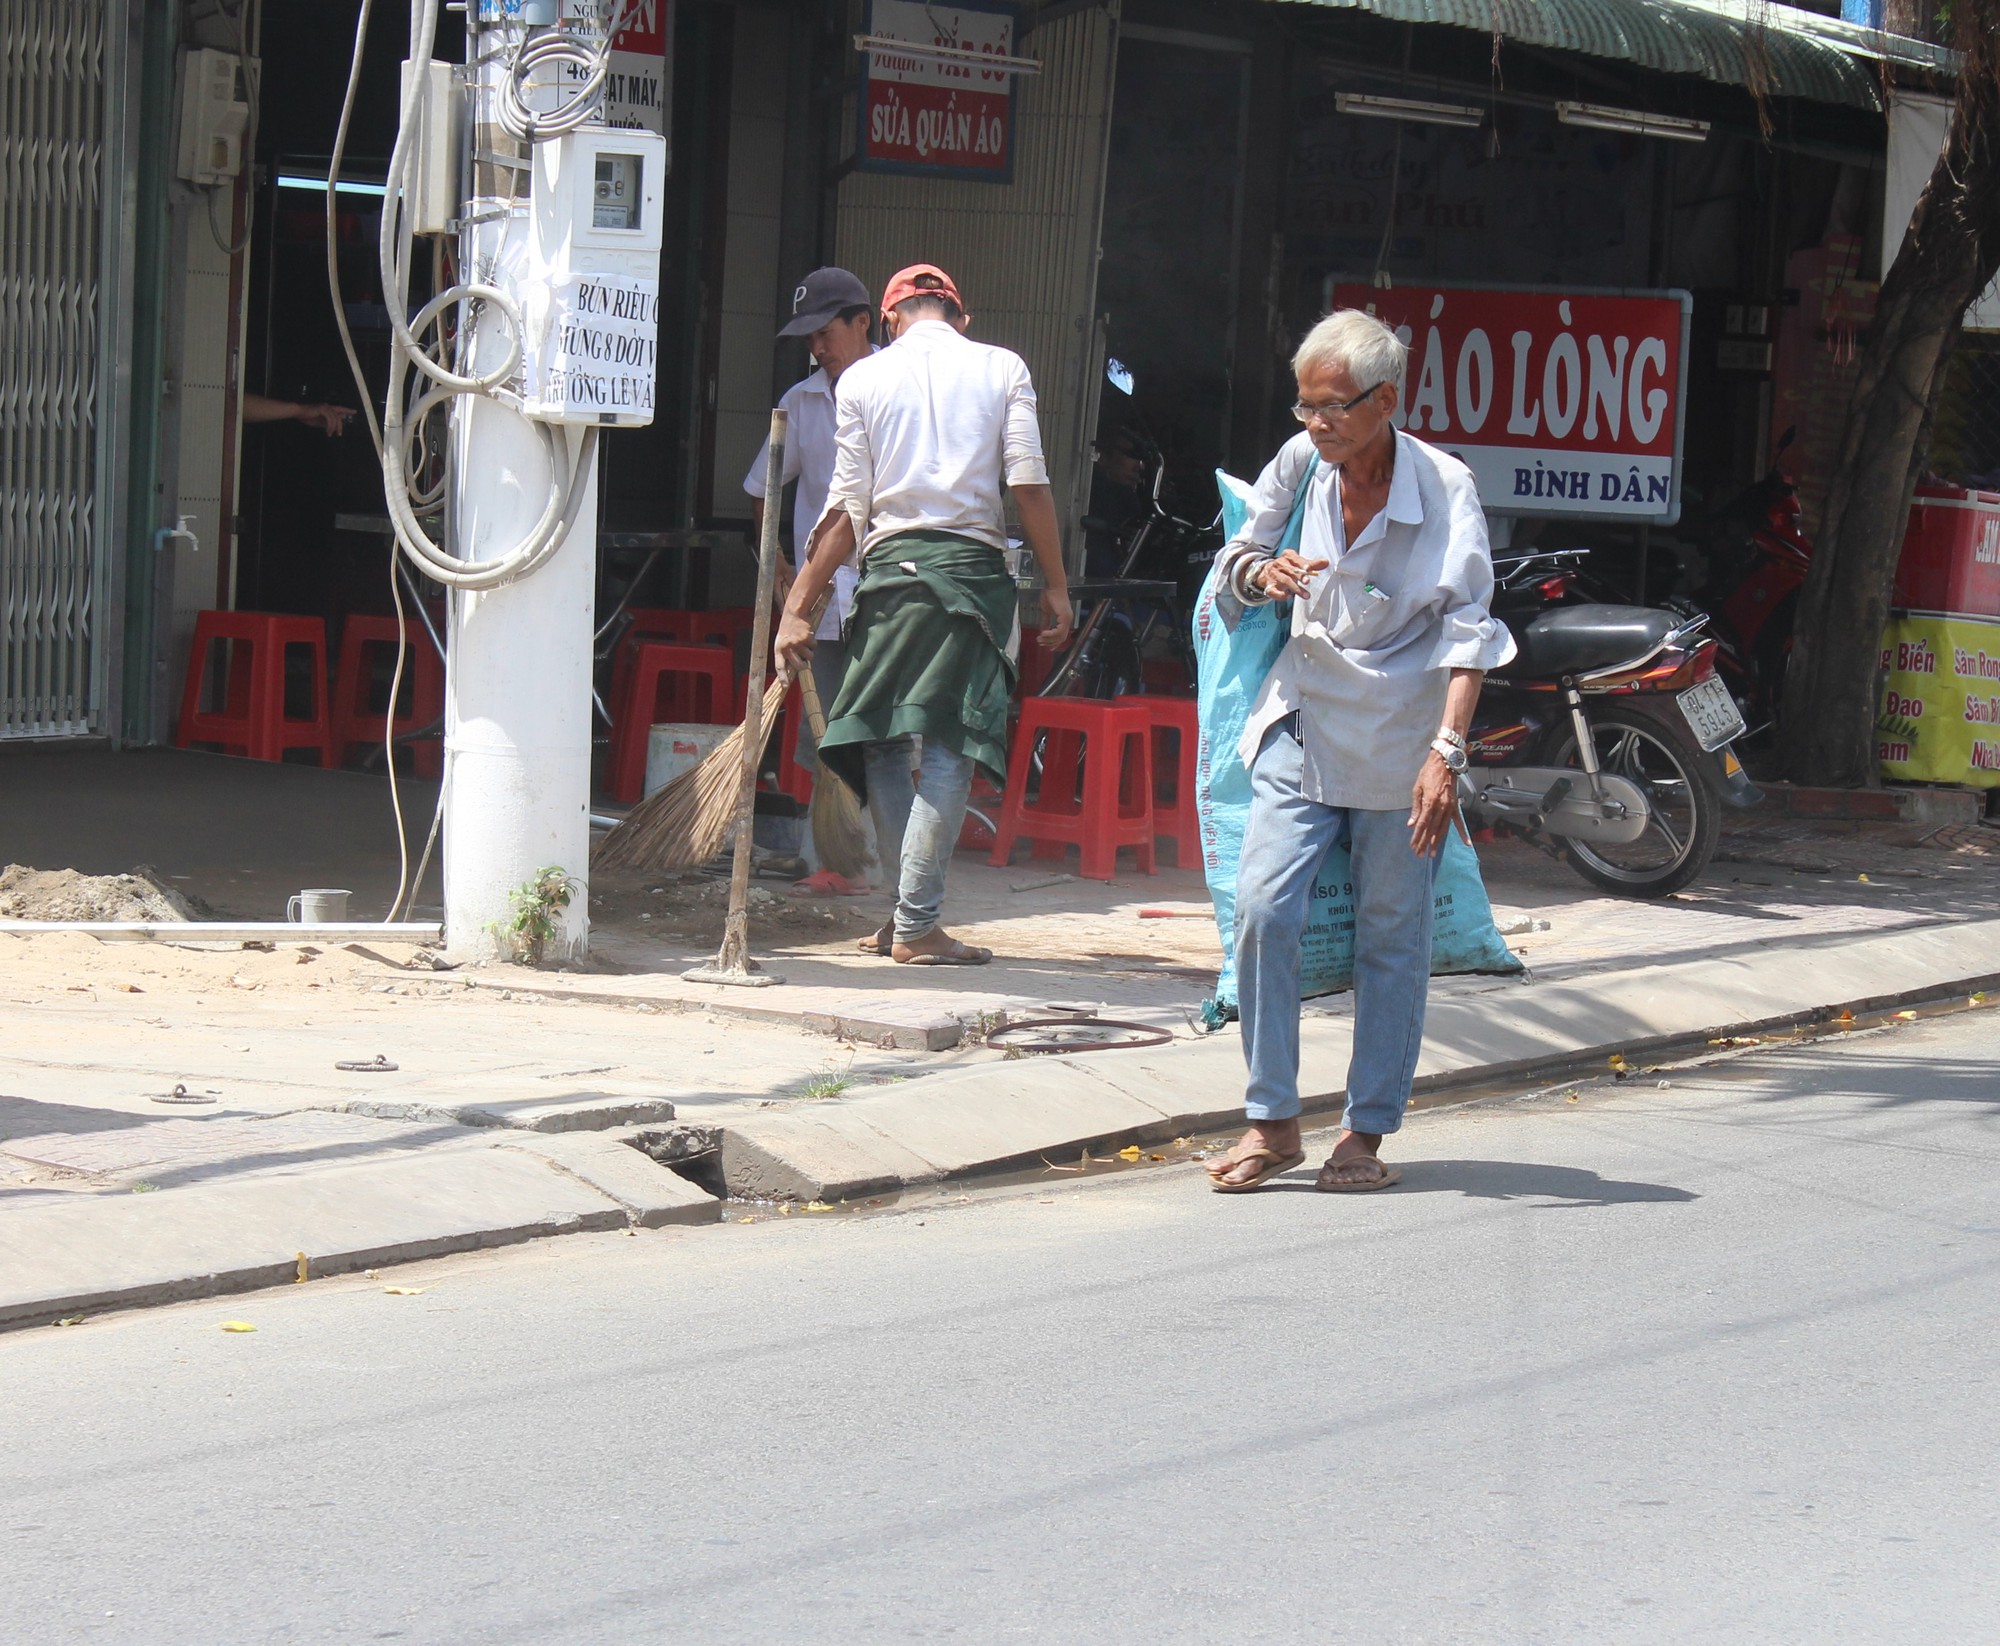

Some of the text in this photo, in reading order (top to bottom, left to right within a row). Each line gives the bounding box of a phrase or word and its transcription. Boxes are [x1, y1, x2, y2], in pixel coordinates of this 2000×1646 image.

[629, 69, 661, 111] MÁY,
[871, 87, 1002, 156] SỬA QUẦN ÁO
[578, 277, 612, 315] BÚN
[612, 283, 651, 322] RIÊU
[792, 286, 807, 315] P
[604, 333, 613, 361] 8
[1394, 294, 1494, 434] ÁO
[1507, 300, 1668, 444] LÒNG
[612, 373, 630, 406] LÊ
[1512, 461, 1670, 504] BÌNH DÂN
[1897, 639, 1935, 672] Biển
[1955, 648, 1976, 674] Sâm
[1482, 678, 1511, 687] ONDA
[1887, 691, 1923, 717] Đao
[1965, 695, 1988, 721] Sâm
[1468, 740, 1514, 752] DREAM
[1880, 742, 1909, 761] am
